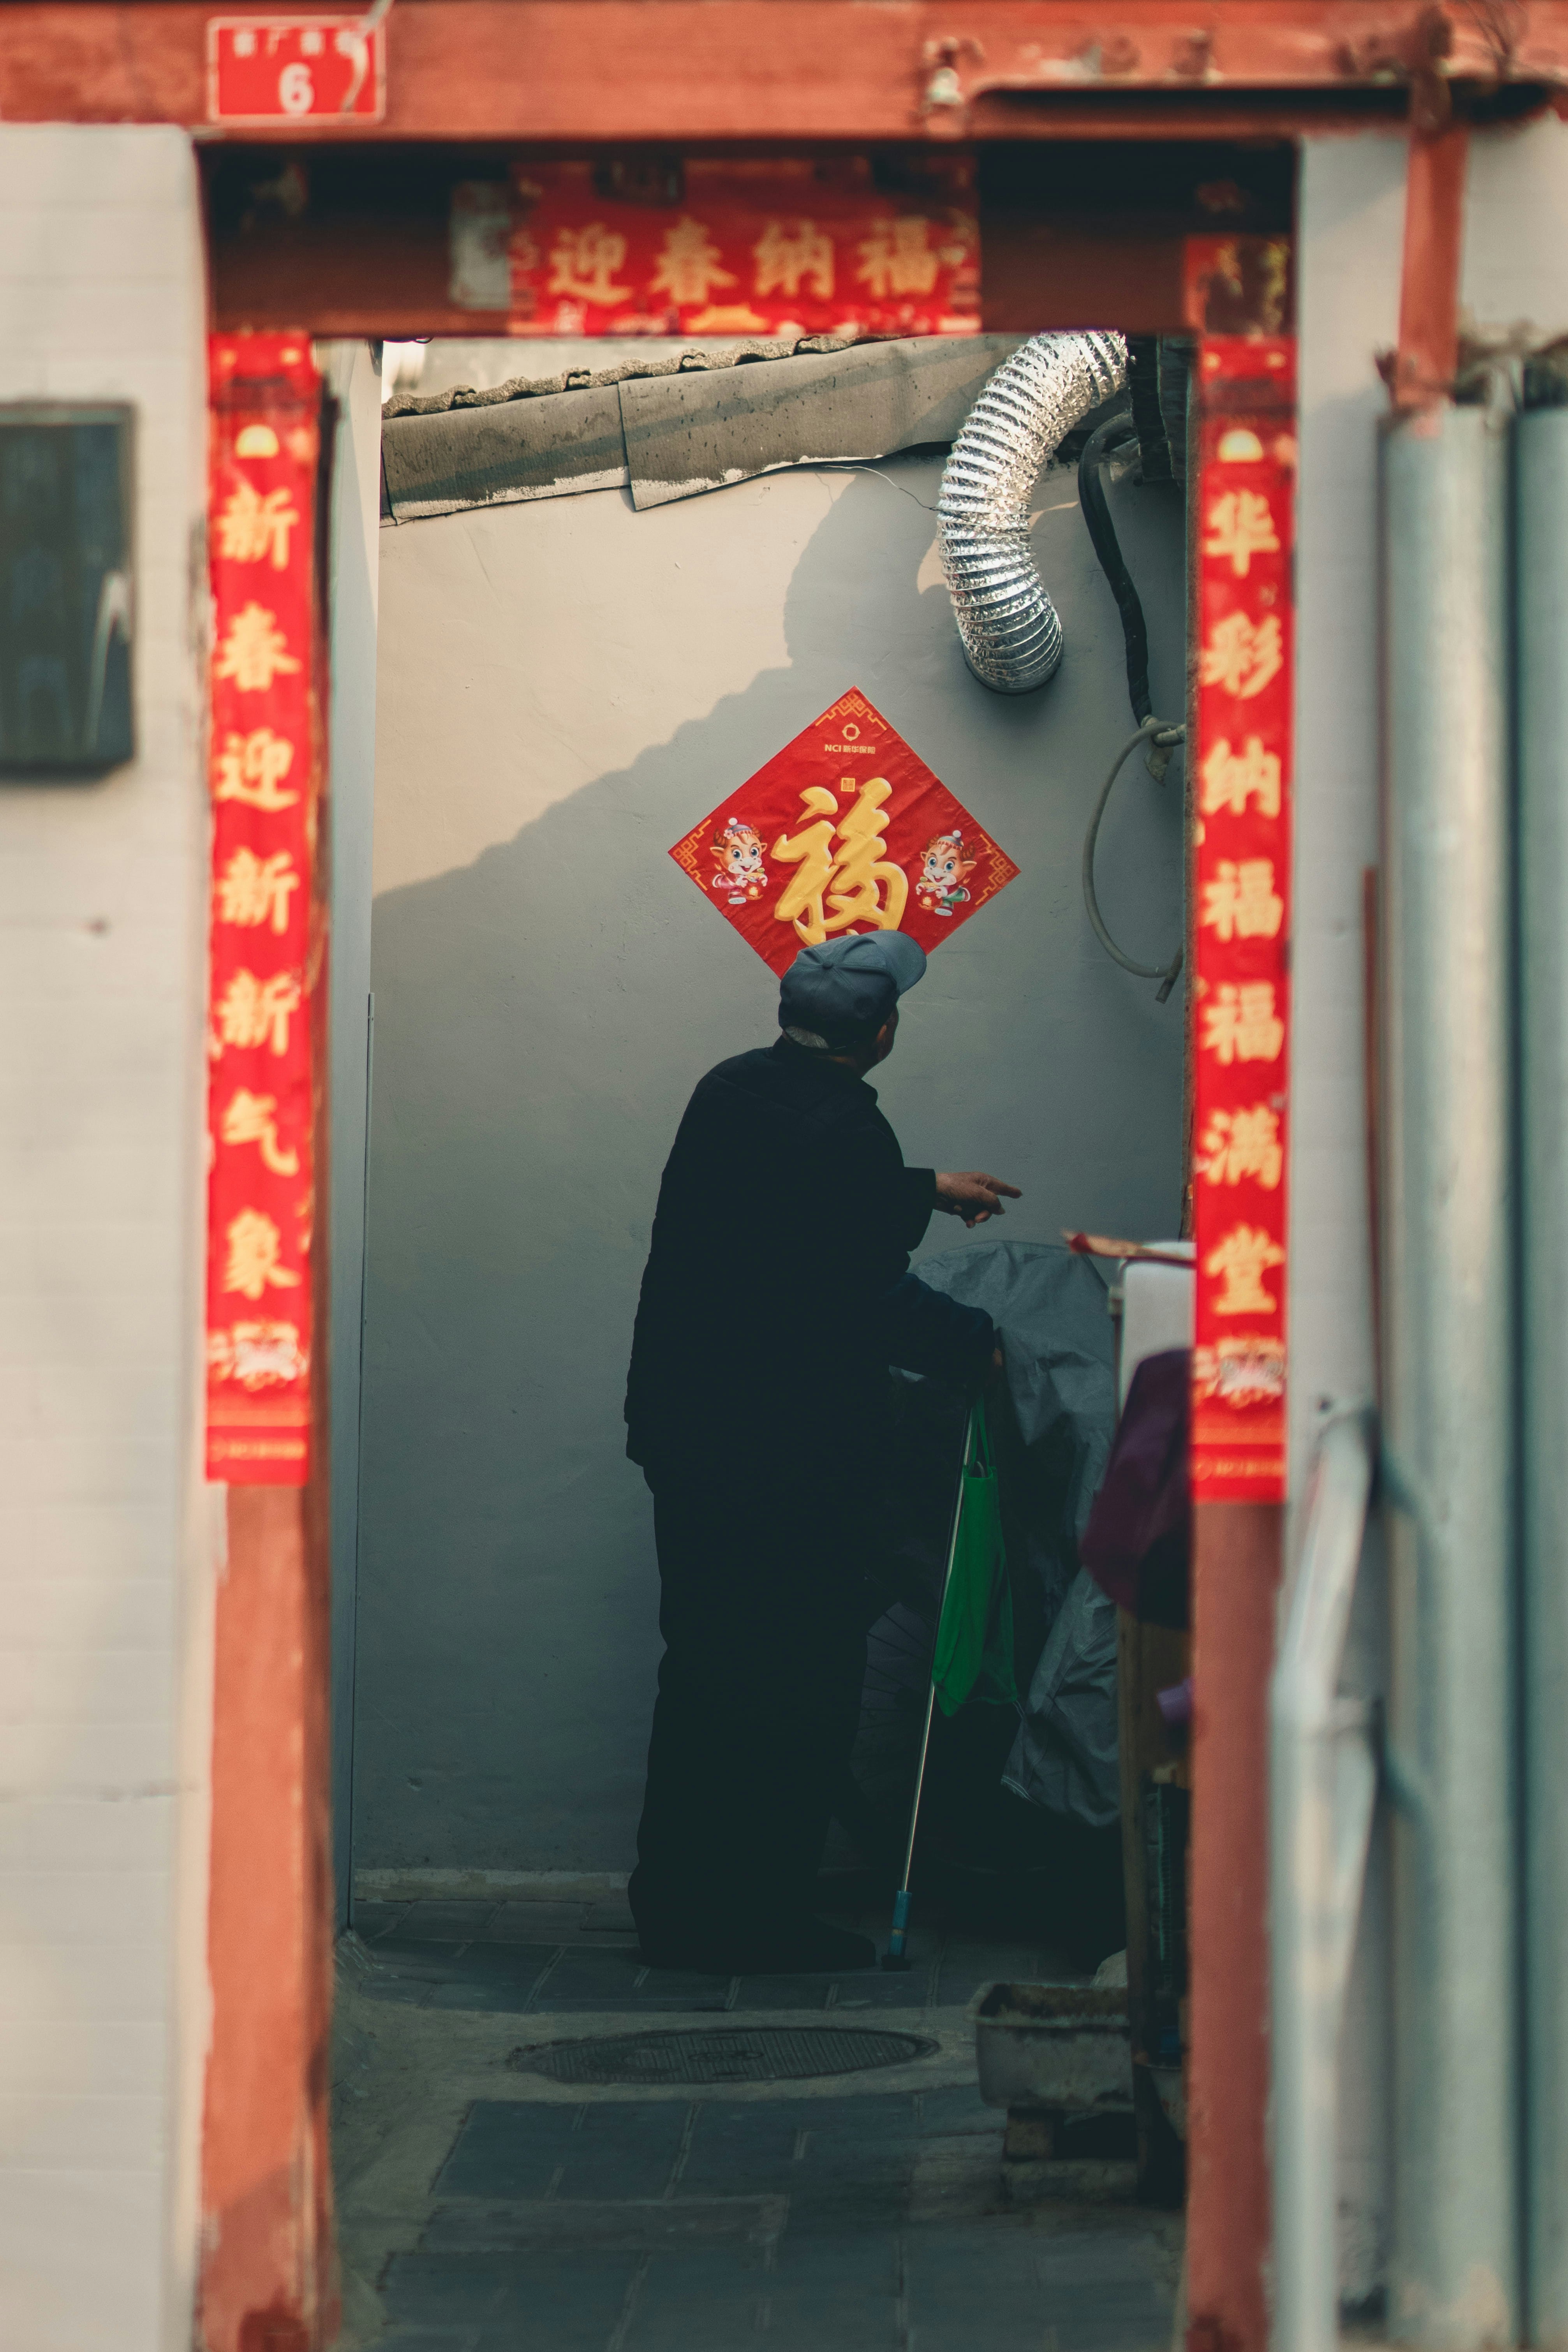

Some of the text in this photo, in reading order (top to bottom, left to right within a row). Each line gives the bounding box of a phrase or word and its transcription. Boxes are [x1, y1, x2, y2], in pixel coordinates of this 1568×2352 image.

[279, 62, 315, 115] 6
[548, 215, 937, 304] 迎春纳福
[825, 744, 842, 752] NCI
[217, 483, 301, 1300] 新春迎新新气象
[770, 777, 909, 947] 福
[1200, 488, 1284, 1316] 华彩纳福福满堂
